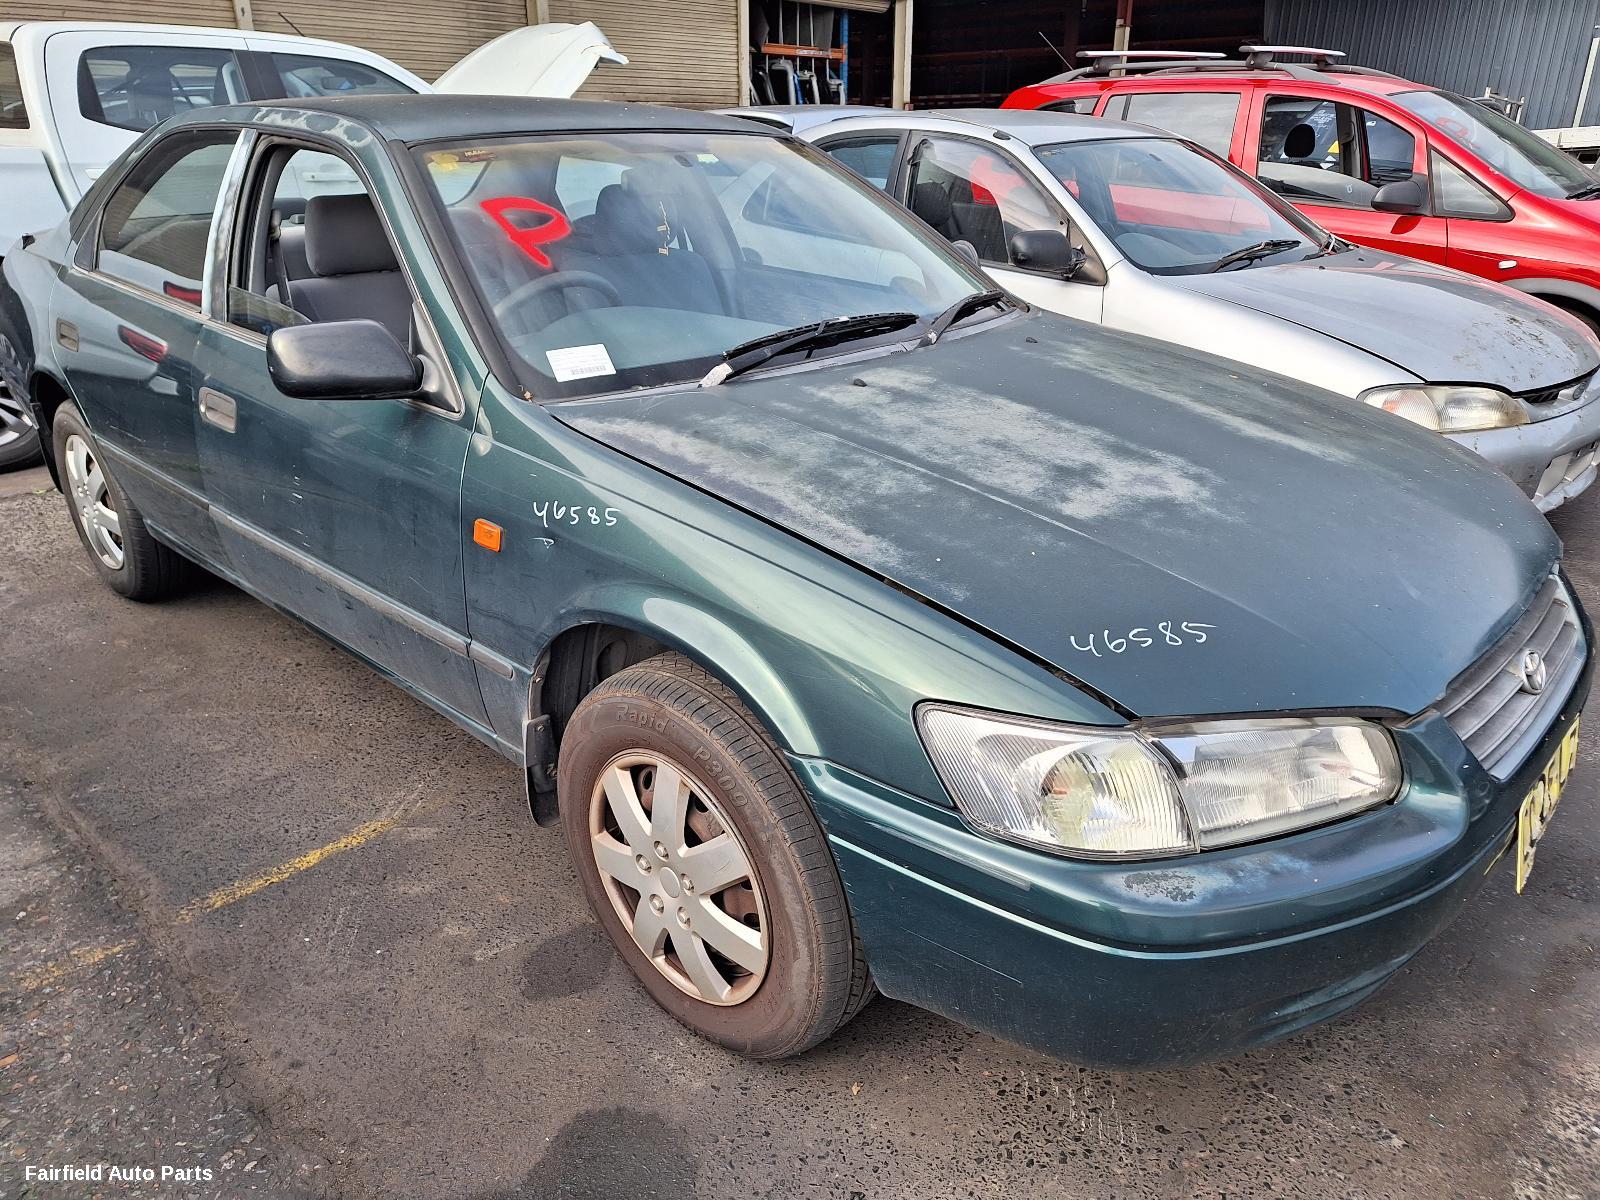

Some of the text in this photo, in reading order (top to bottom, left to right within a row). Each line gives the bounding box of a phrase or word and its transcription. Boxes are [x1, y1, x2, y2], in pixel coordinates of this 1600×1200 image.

[480, 196, 571, 268] P
[533, 500, 621, 528] 46585
[1070, 620, 1218, 657] 46585
[615, 704, 672, 734] Rapid
